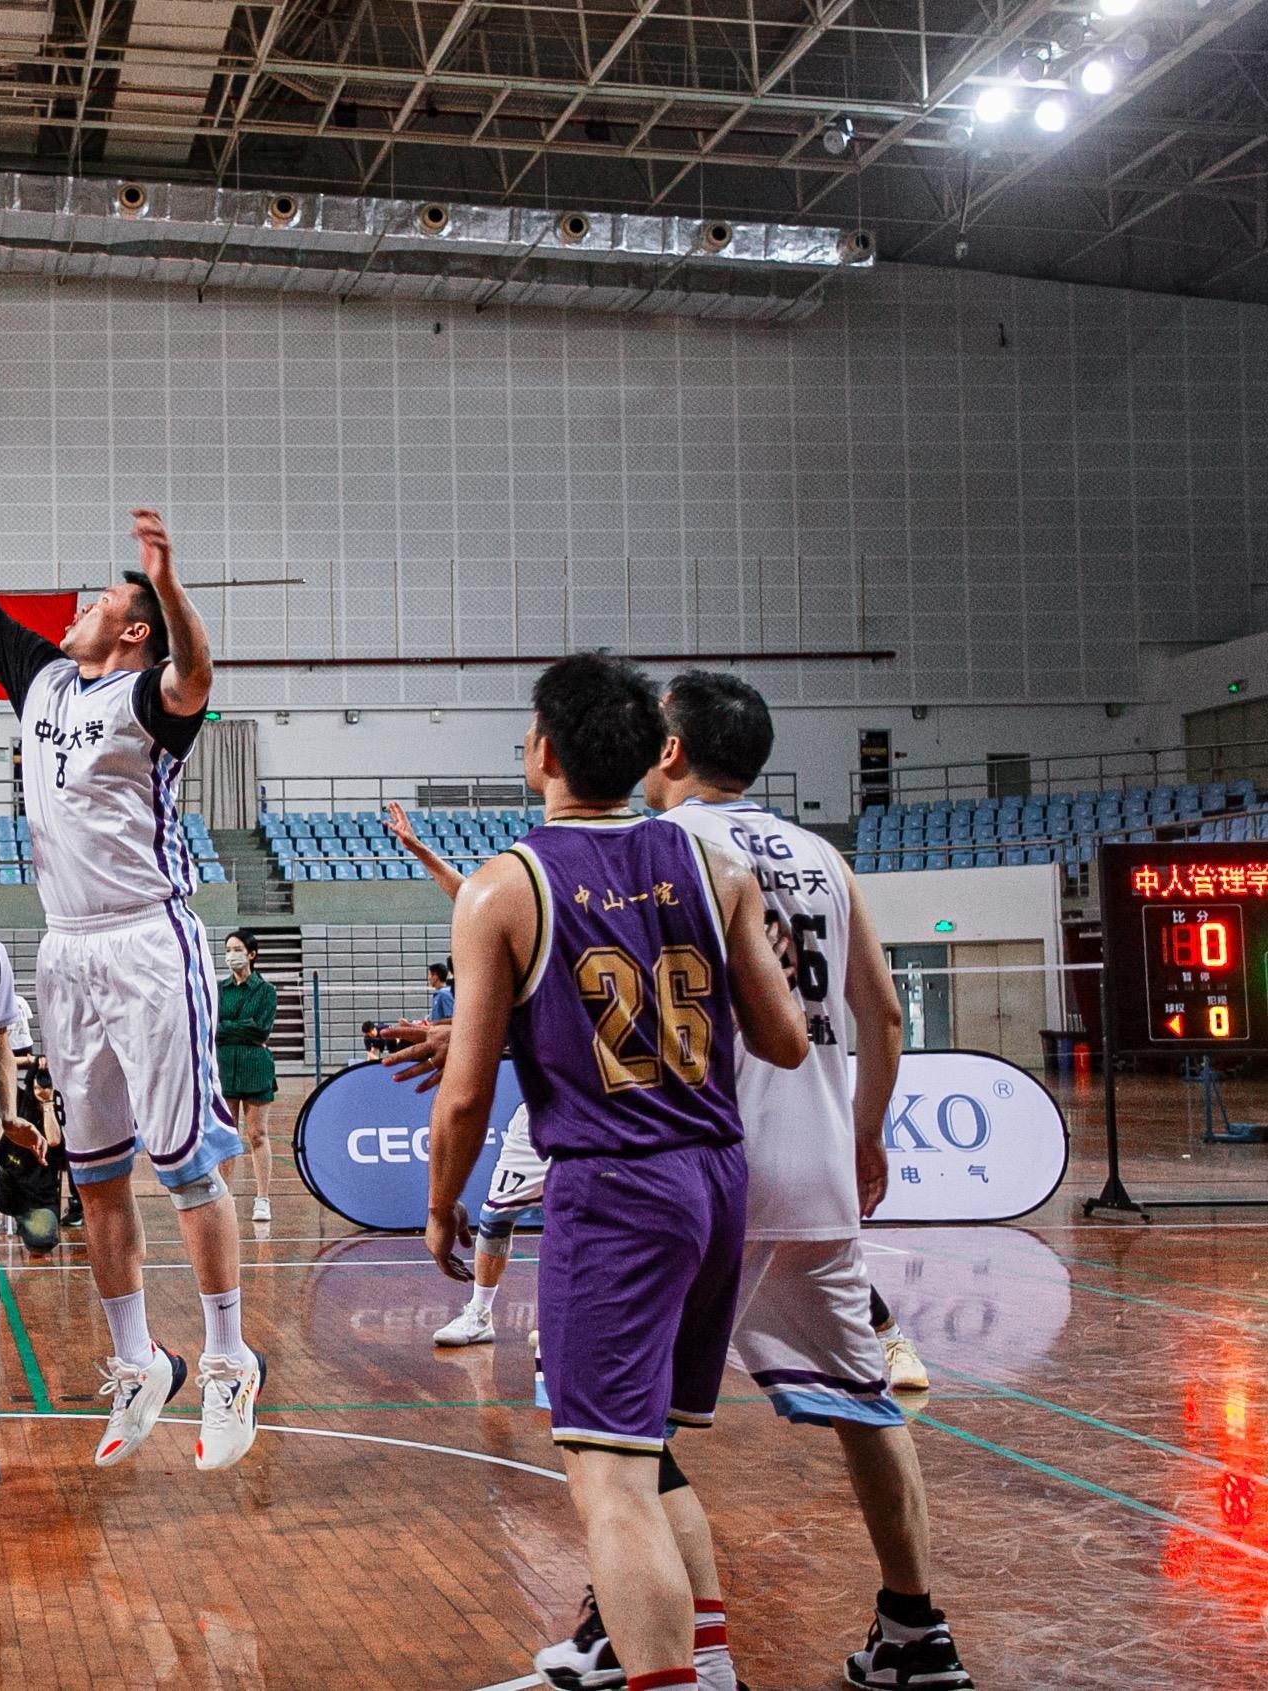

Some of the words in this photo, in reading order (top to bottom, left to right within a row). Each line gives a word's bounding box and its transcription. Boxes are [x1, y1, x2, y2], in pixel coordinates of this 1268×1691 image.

[751, 867, 829, 896] 业中天
[574, 881, 679, 913] 中山一院
[1172, 910, 1209, 924] 比分
[573, 945, 713, 1093] 26
[1208, 1005, 1230, 1037] 0
[497, 1170, 526, 1194] 17
